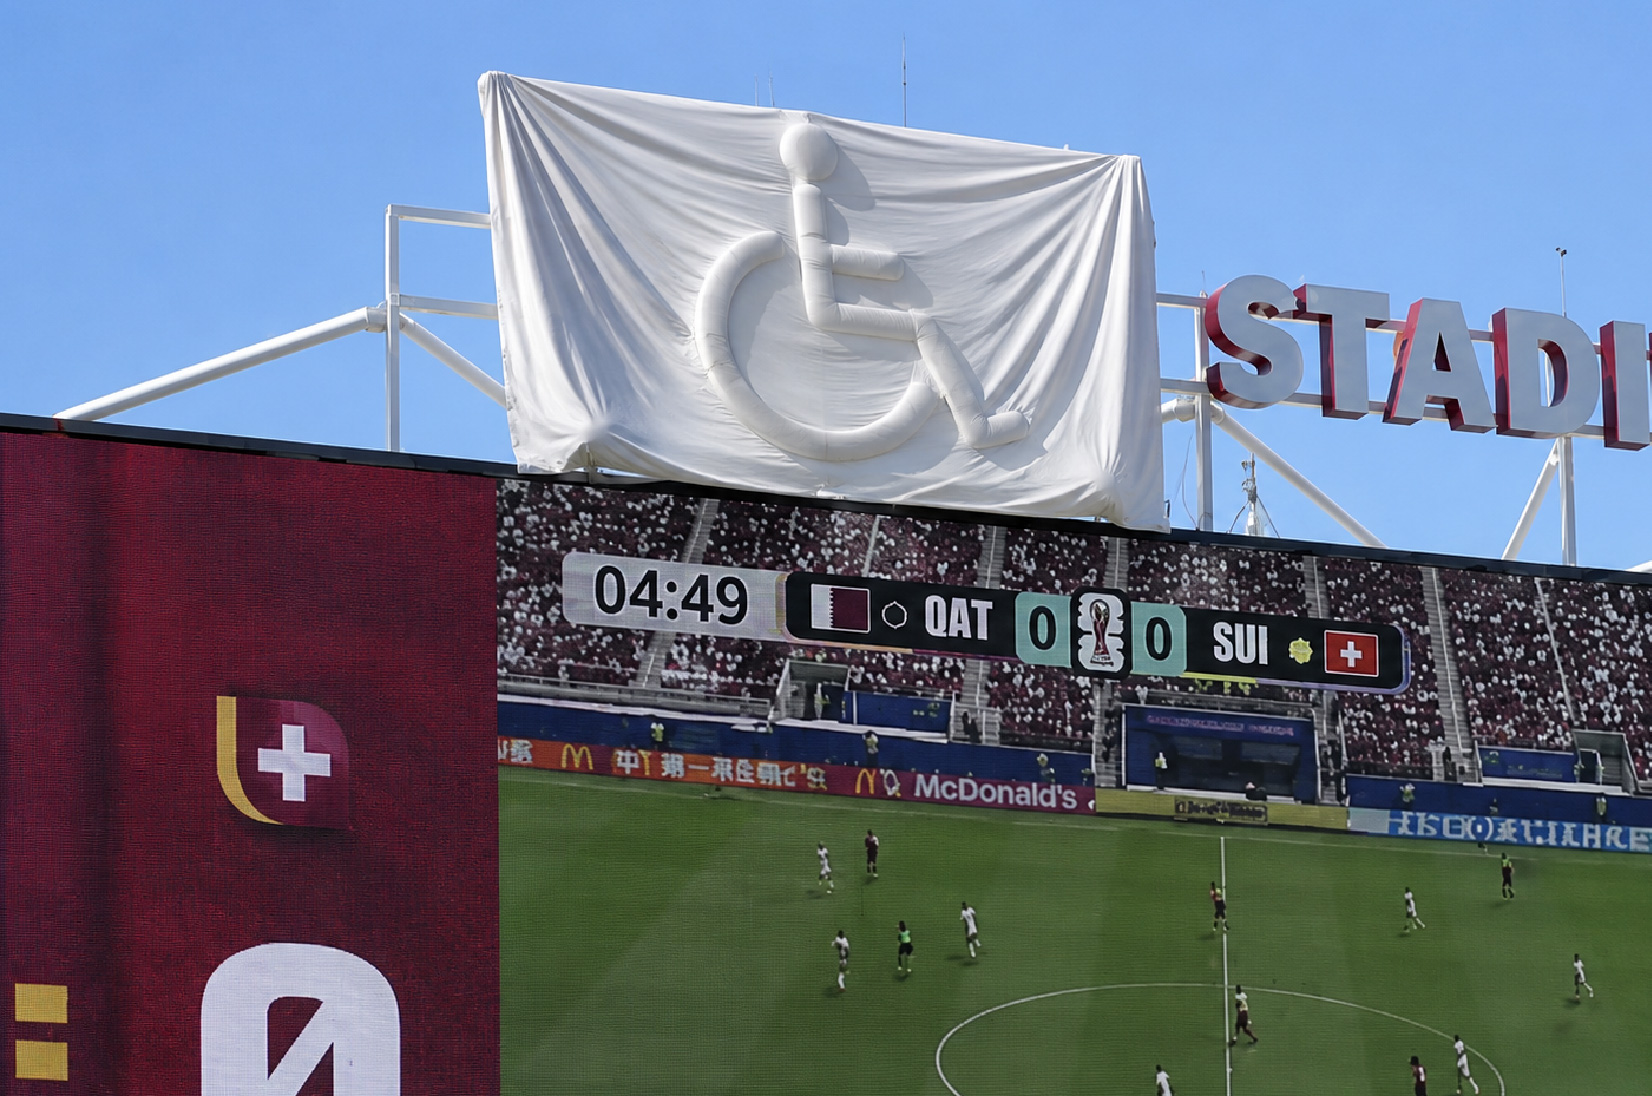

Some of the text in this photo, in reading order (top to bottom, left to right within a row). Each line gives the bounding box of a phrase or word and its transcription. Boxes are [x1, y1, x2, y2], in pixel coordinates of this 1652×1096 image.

[1205, 274, 1652, 452] STADI
[595, 565, 1269, 665] 04:49 QAT 0 0 SUI
[914, 773, 1078, 810] McDonald's
